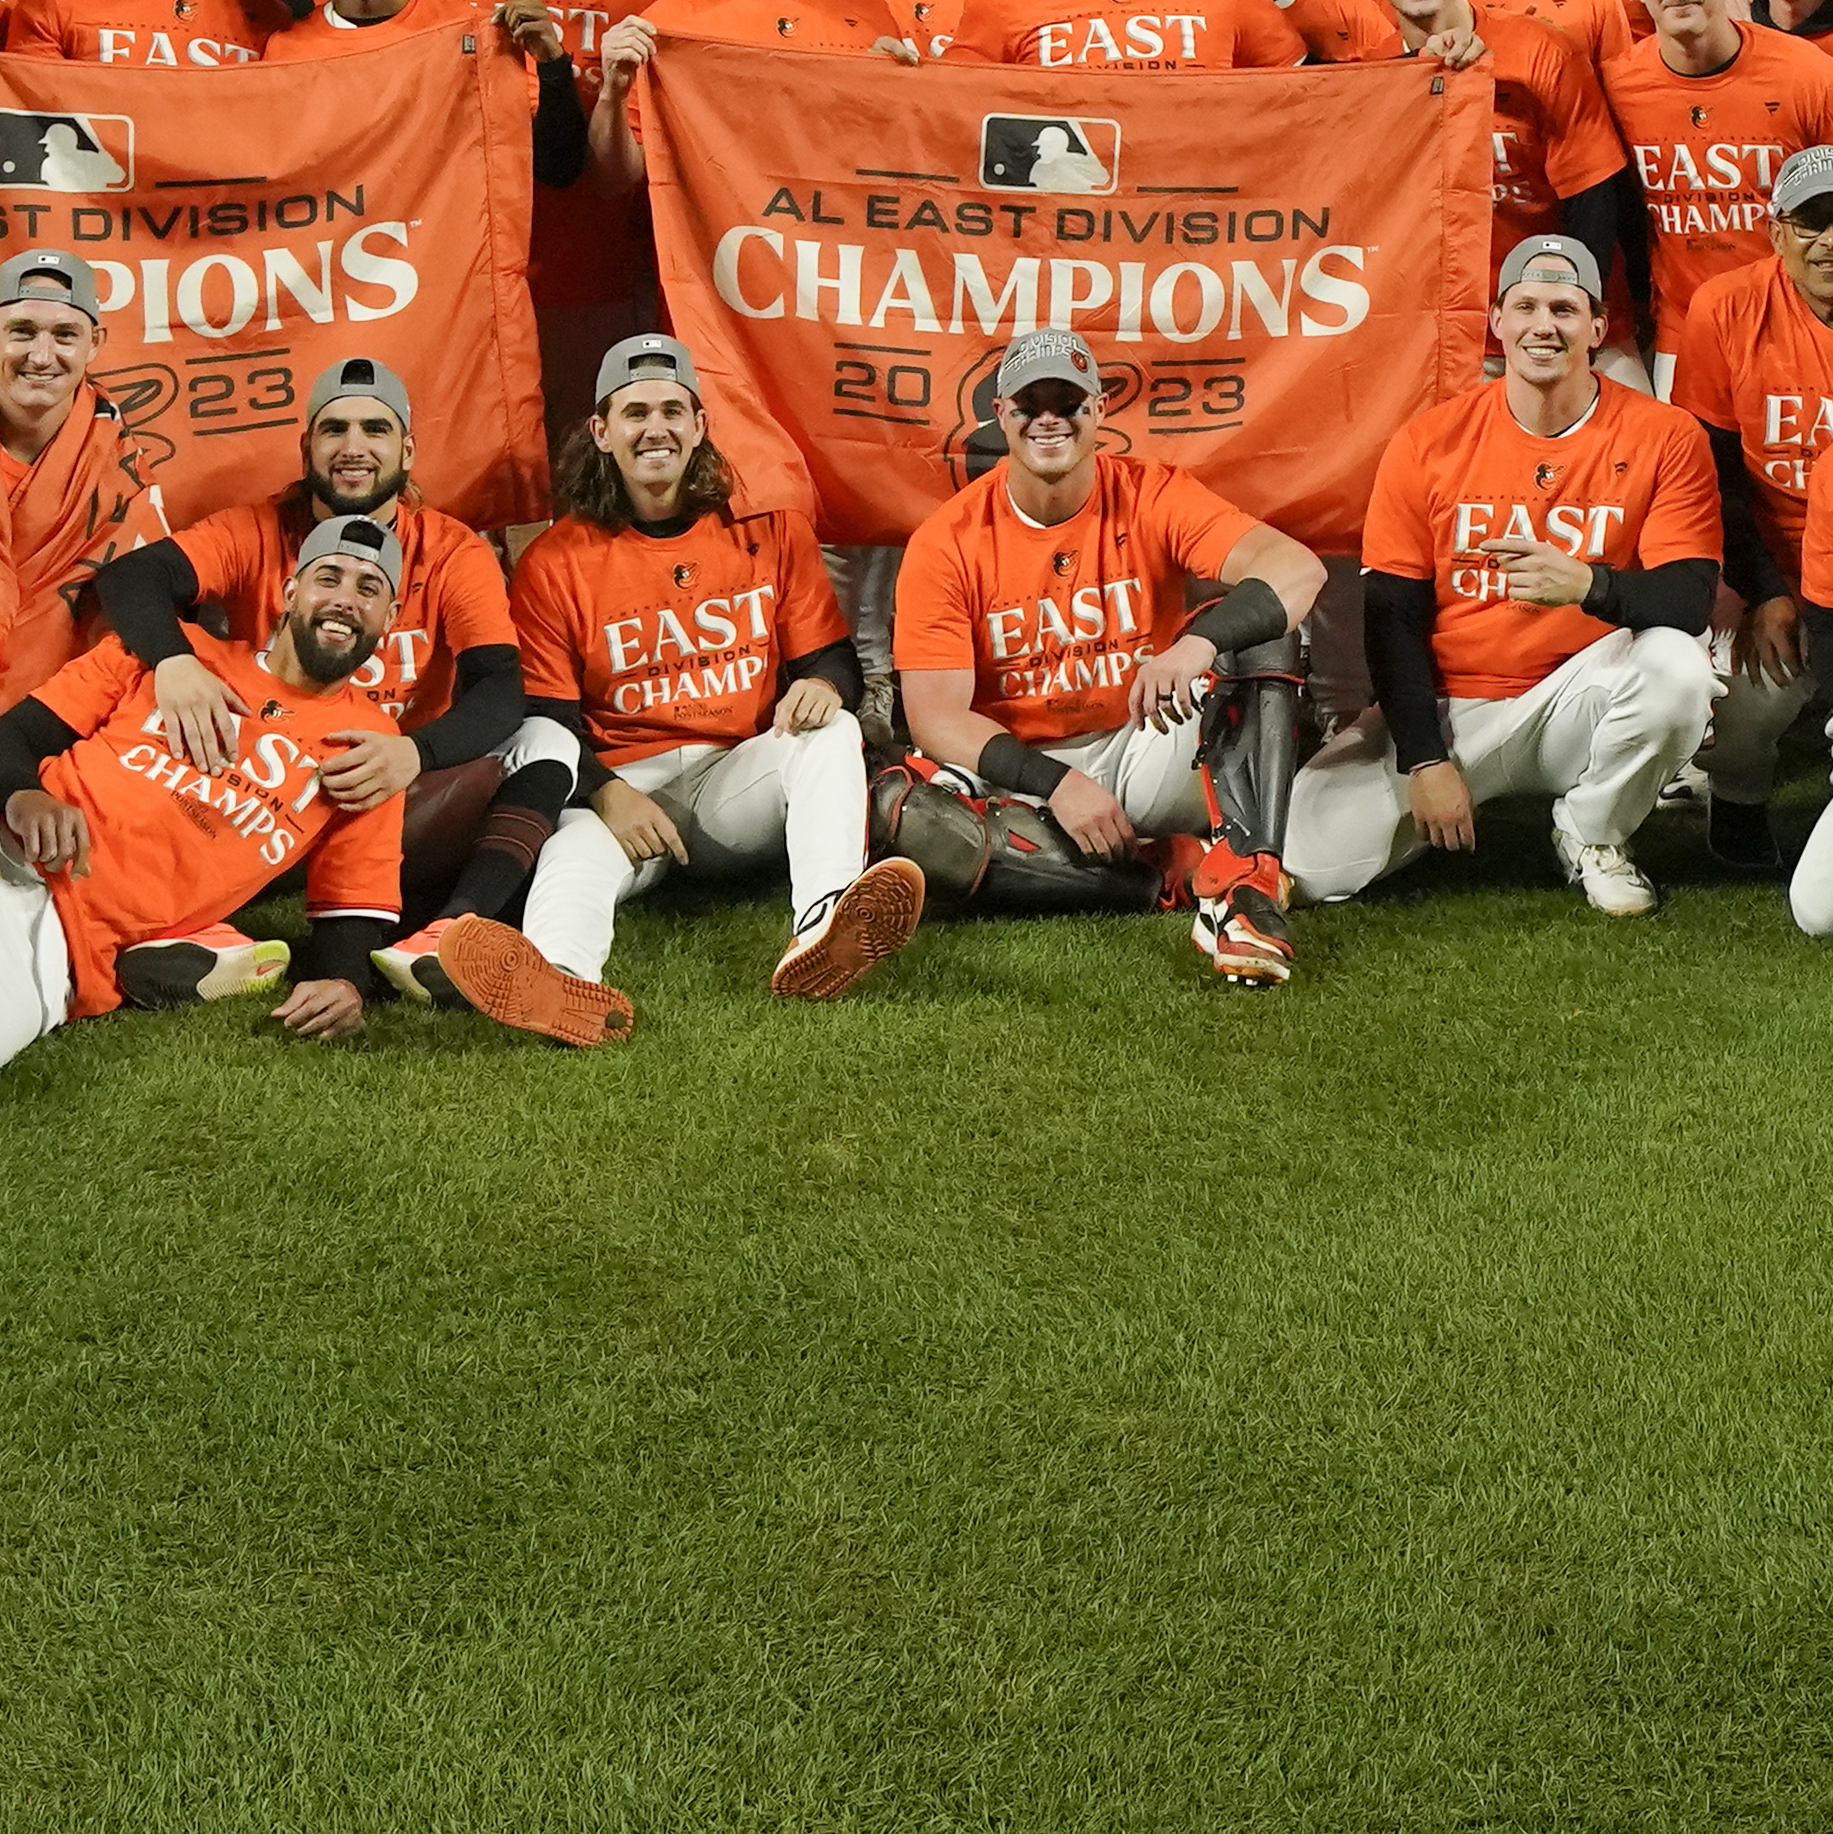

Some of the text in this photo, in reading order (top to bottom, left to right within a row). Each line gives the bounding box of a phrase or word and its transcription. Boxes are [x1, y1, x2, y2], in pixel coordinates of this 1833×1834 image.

[1037, 15, 1208, 67] EAST
[1633, 142, 1784, 192] EAST
[71, 184, 366, 243] DIVISION
[762, 187, 1332, 244] AL EAST DIVISION
[712, 224, 1371, 344] CHAMPIONS
[188, 366, 296, 420] 23
[833, 360, 1246, 418] 20 23
[1455, 501, 1626, 559] EAST
[604, 584, 777, 675] EAST
[984, 577, 1143, 664] EAST
[349, 628, 430, 689] ST
[648, 643, 751, 679] DIVISION
[998, 642, 1157, 701] CHAMPS
[1028, 638, 1120, 669] DIVISION
[613, 655, 771, 715] CHAMP
[673, 706, 735, 722] POSTSEASON
[118, 742, 297, 868] CHAMPS
